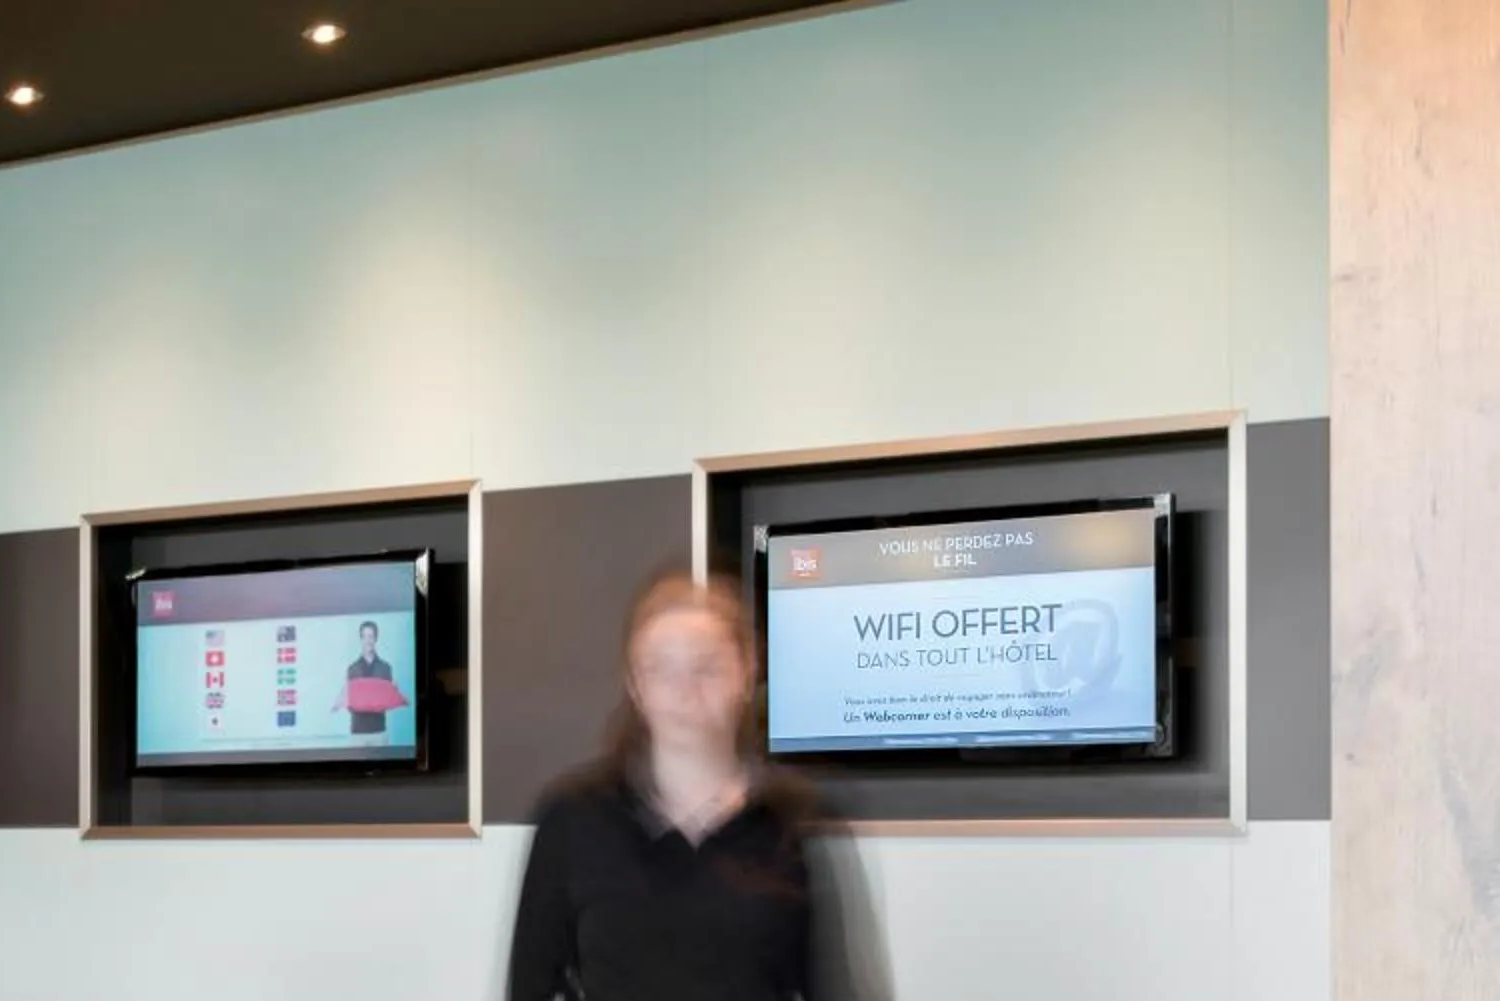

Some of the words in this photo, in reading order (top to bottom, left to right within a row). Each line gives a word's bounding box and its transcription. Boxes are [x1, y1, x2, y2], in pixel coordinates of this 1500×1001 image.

[878, 540, 919, 556] VOUS
[922, 538, 943, 552] NE
[945, 534, 1002, 551] PERDEZ
[1005, 531, 1034, 546] PAS
[933, 555, 951, 568] LE
[955, 552, 977, 567] FIL
[853, 611, 921, 641] WIFI
[931, 603, 1063, 638] OFFERT
[856, 650, 911, 669] DANS
[915, 647, 971, 667] TOUT
[976, 639, 1058, 664] L'HÔTEL
[965, 706, 998, 720] votre
